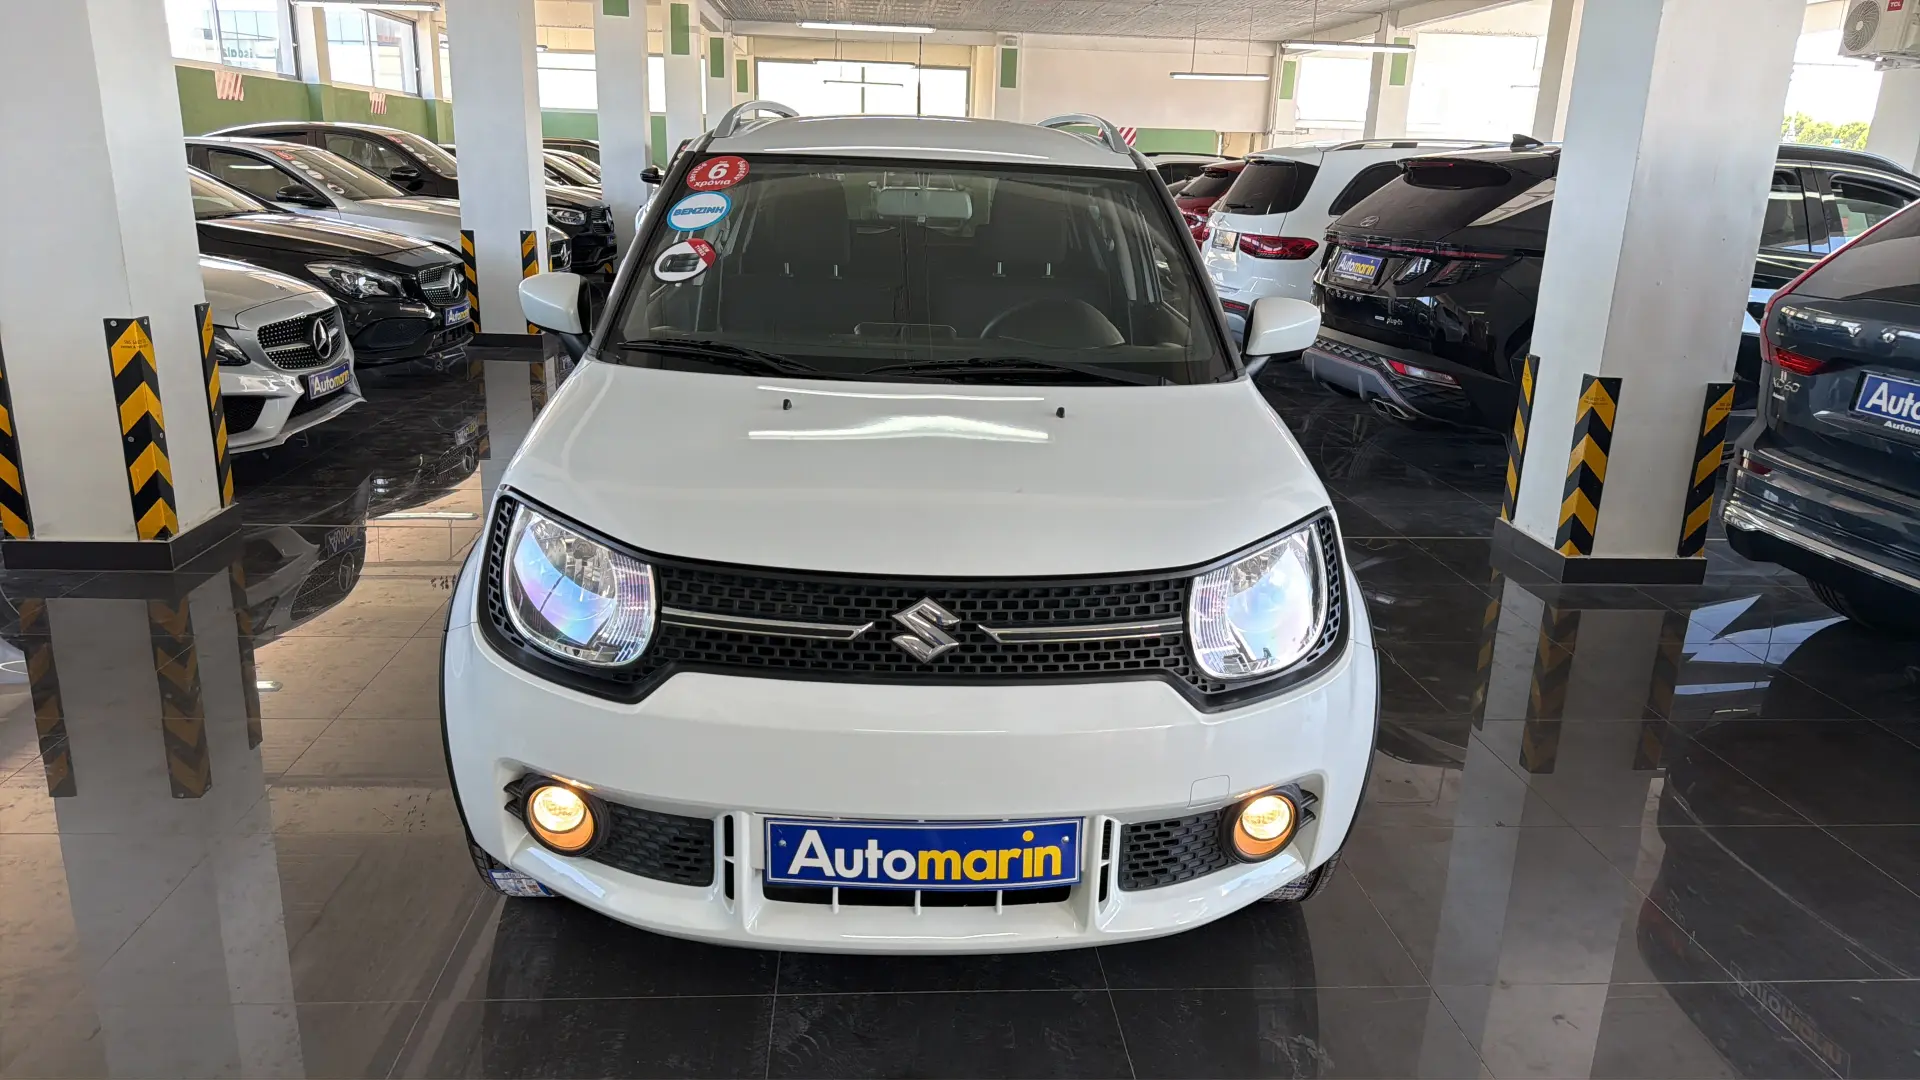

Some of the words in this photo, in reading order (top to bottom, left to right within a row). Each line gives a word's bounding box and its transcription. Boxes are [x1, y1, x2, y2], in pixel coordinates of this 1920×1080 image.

[708, 163, 730, 180] 6
[1337, 255, 1375, 276] Automarin
[787, 829, 1062, 881] Automarin
